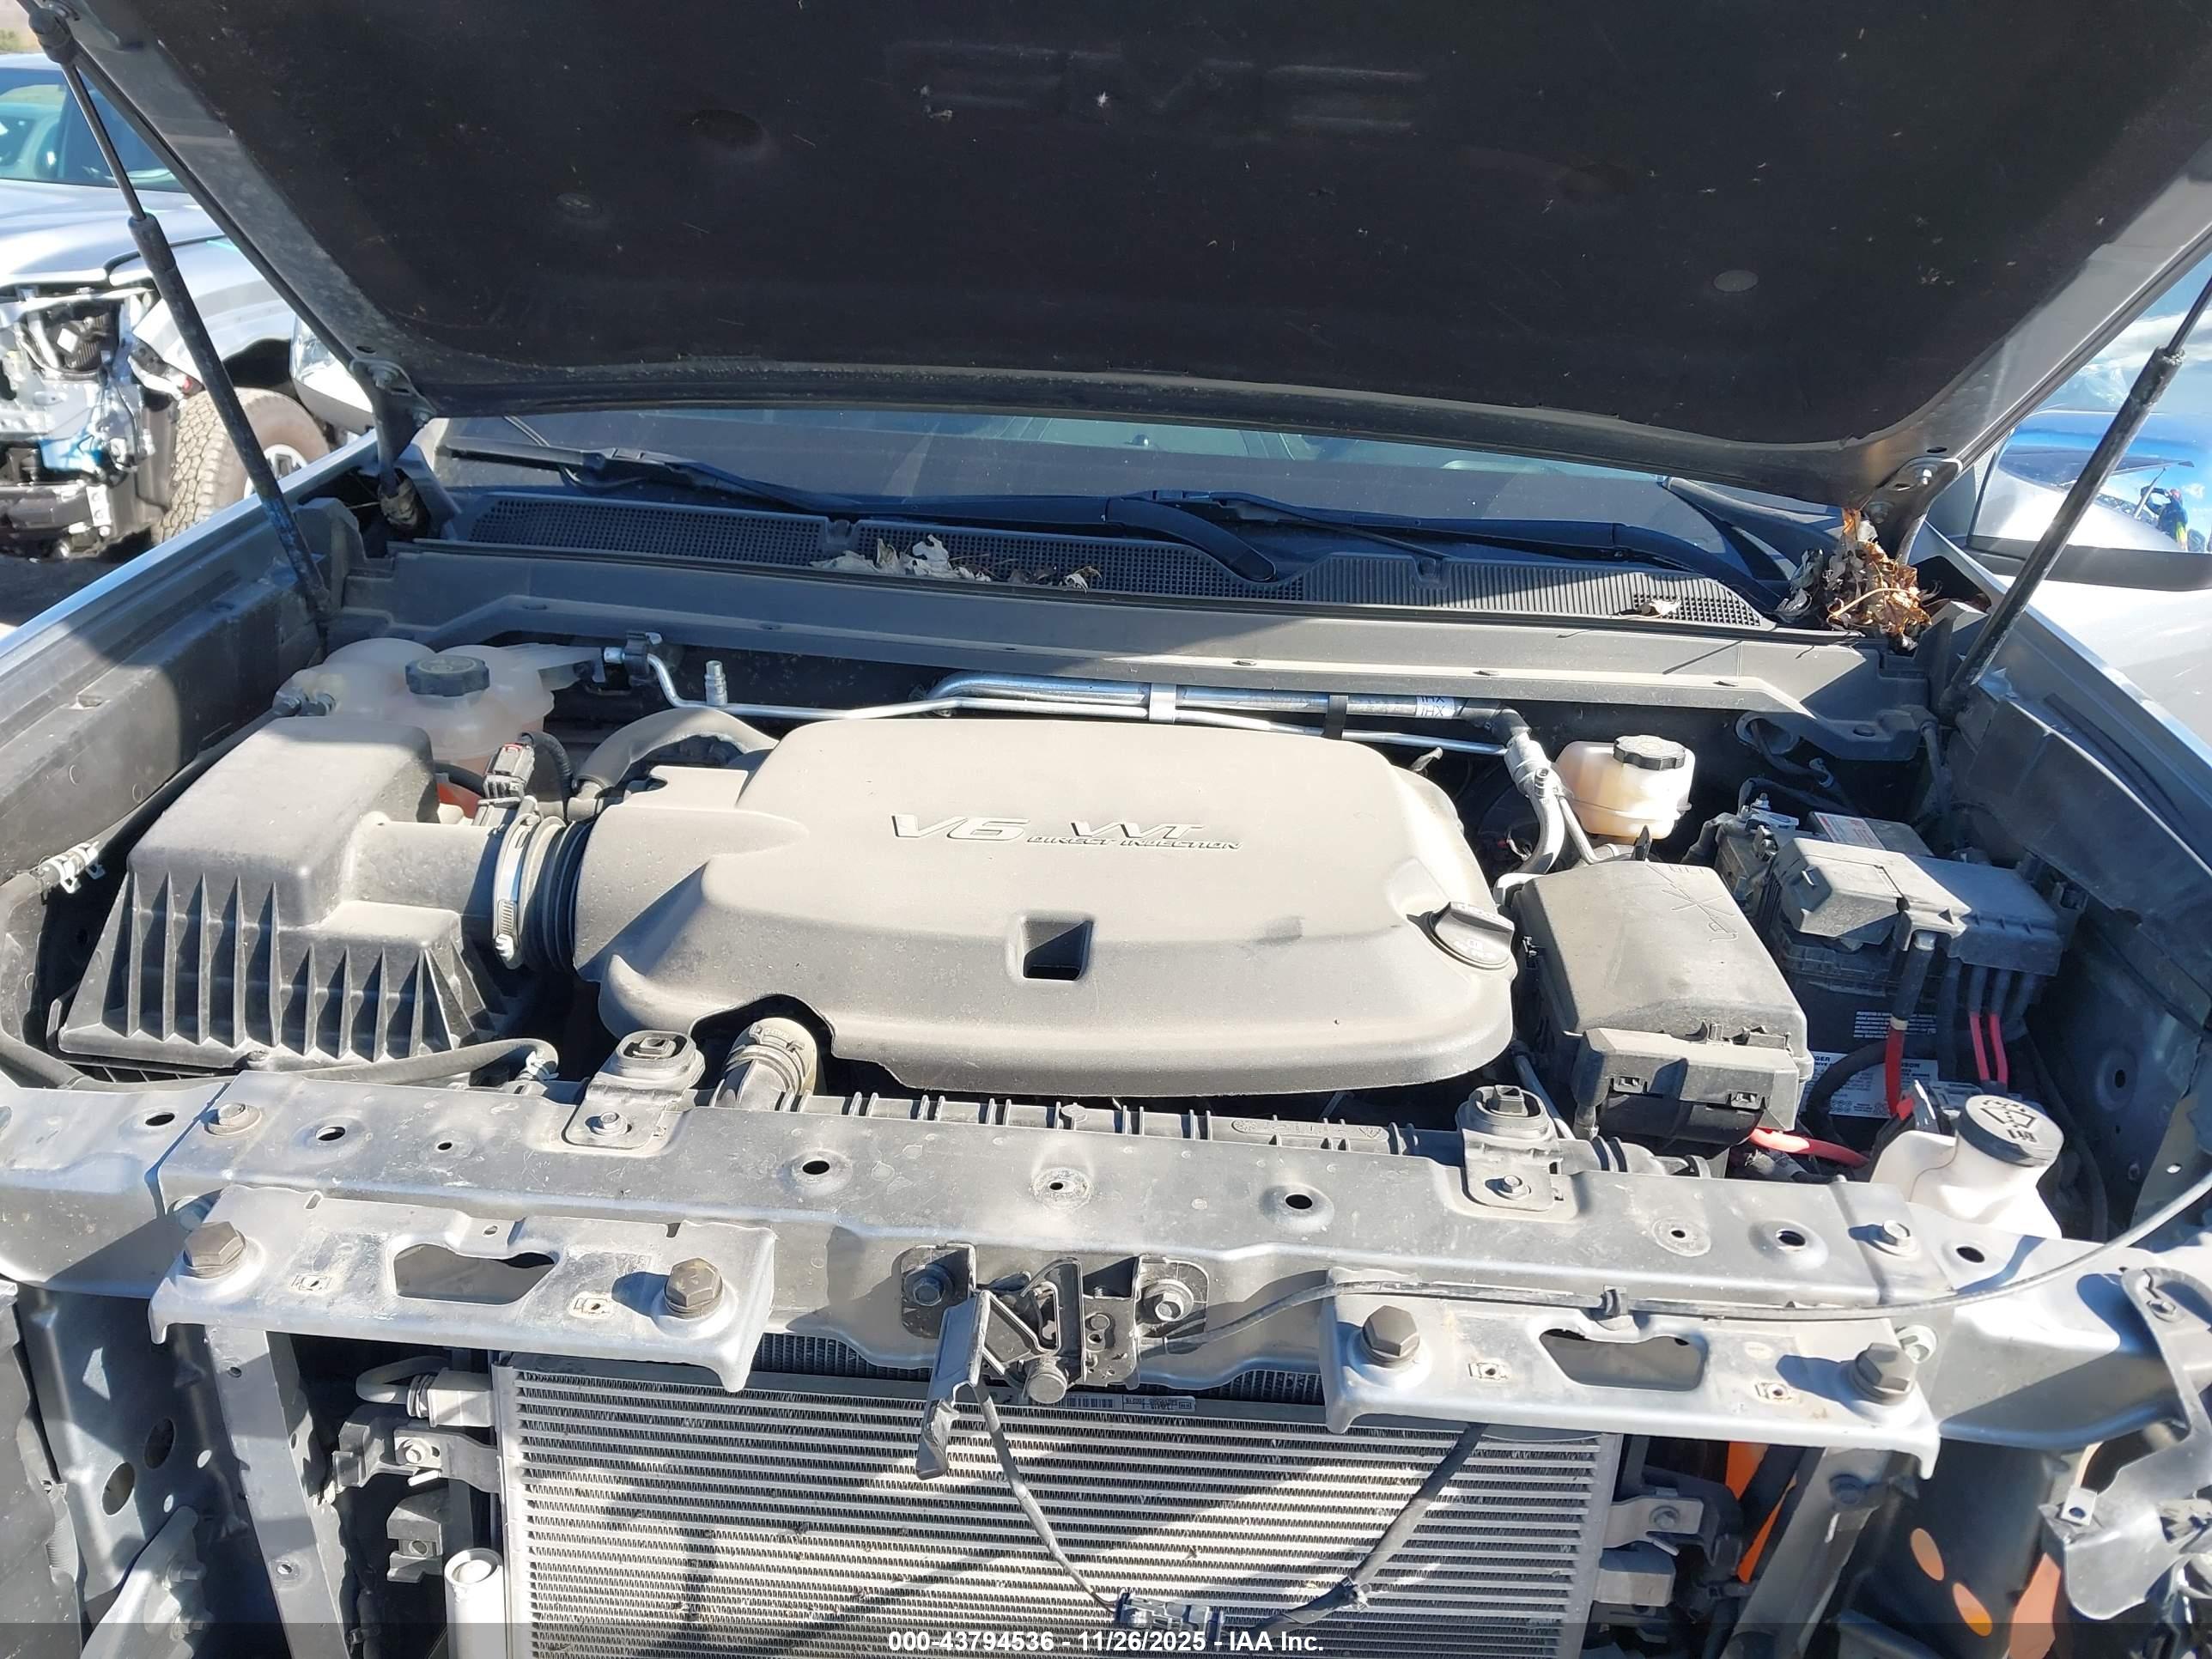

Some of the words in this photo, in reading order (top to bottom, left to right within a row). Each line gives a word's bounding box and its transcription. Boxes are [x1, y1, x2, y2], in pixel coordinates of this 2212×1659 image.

[891, 814, 1030, 842] V6
[1069, 820, 1205, 839] VVT
[1027, 836, 1116, 845] DIRECT
[1120, 839, 1243, 849] INJECTION
